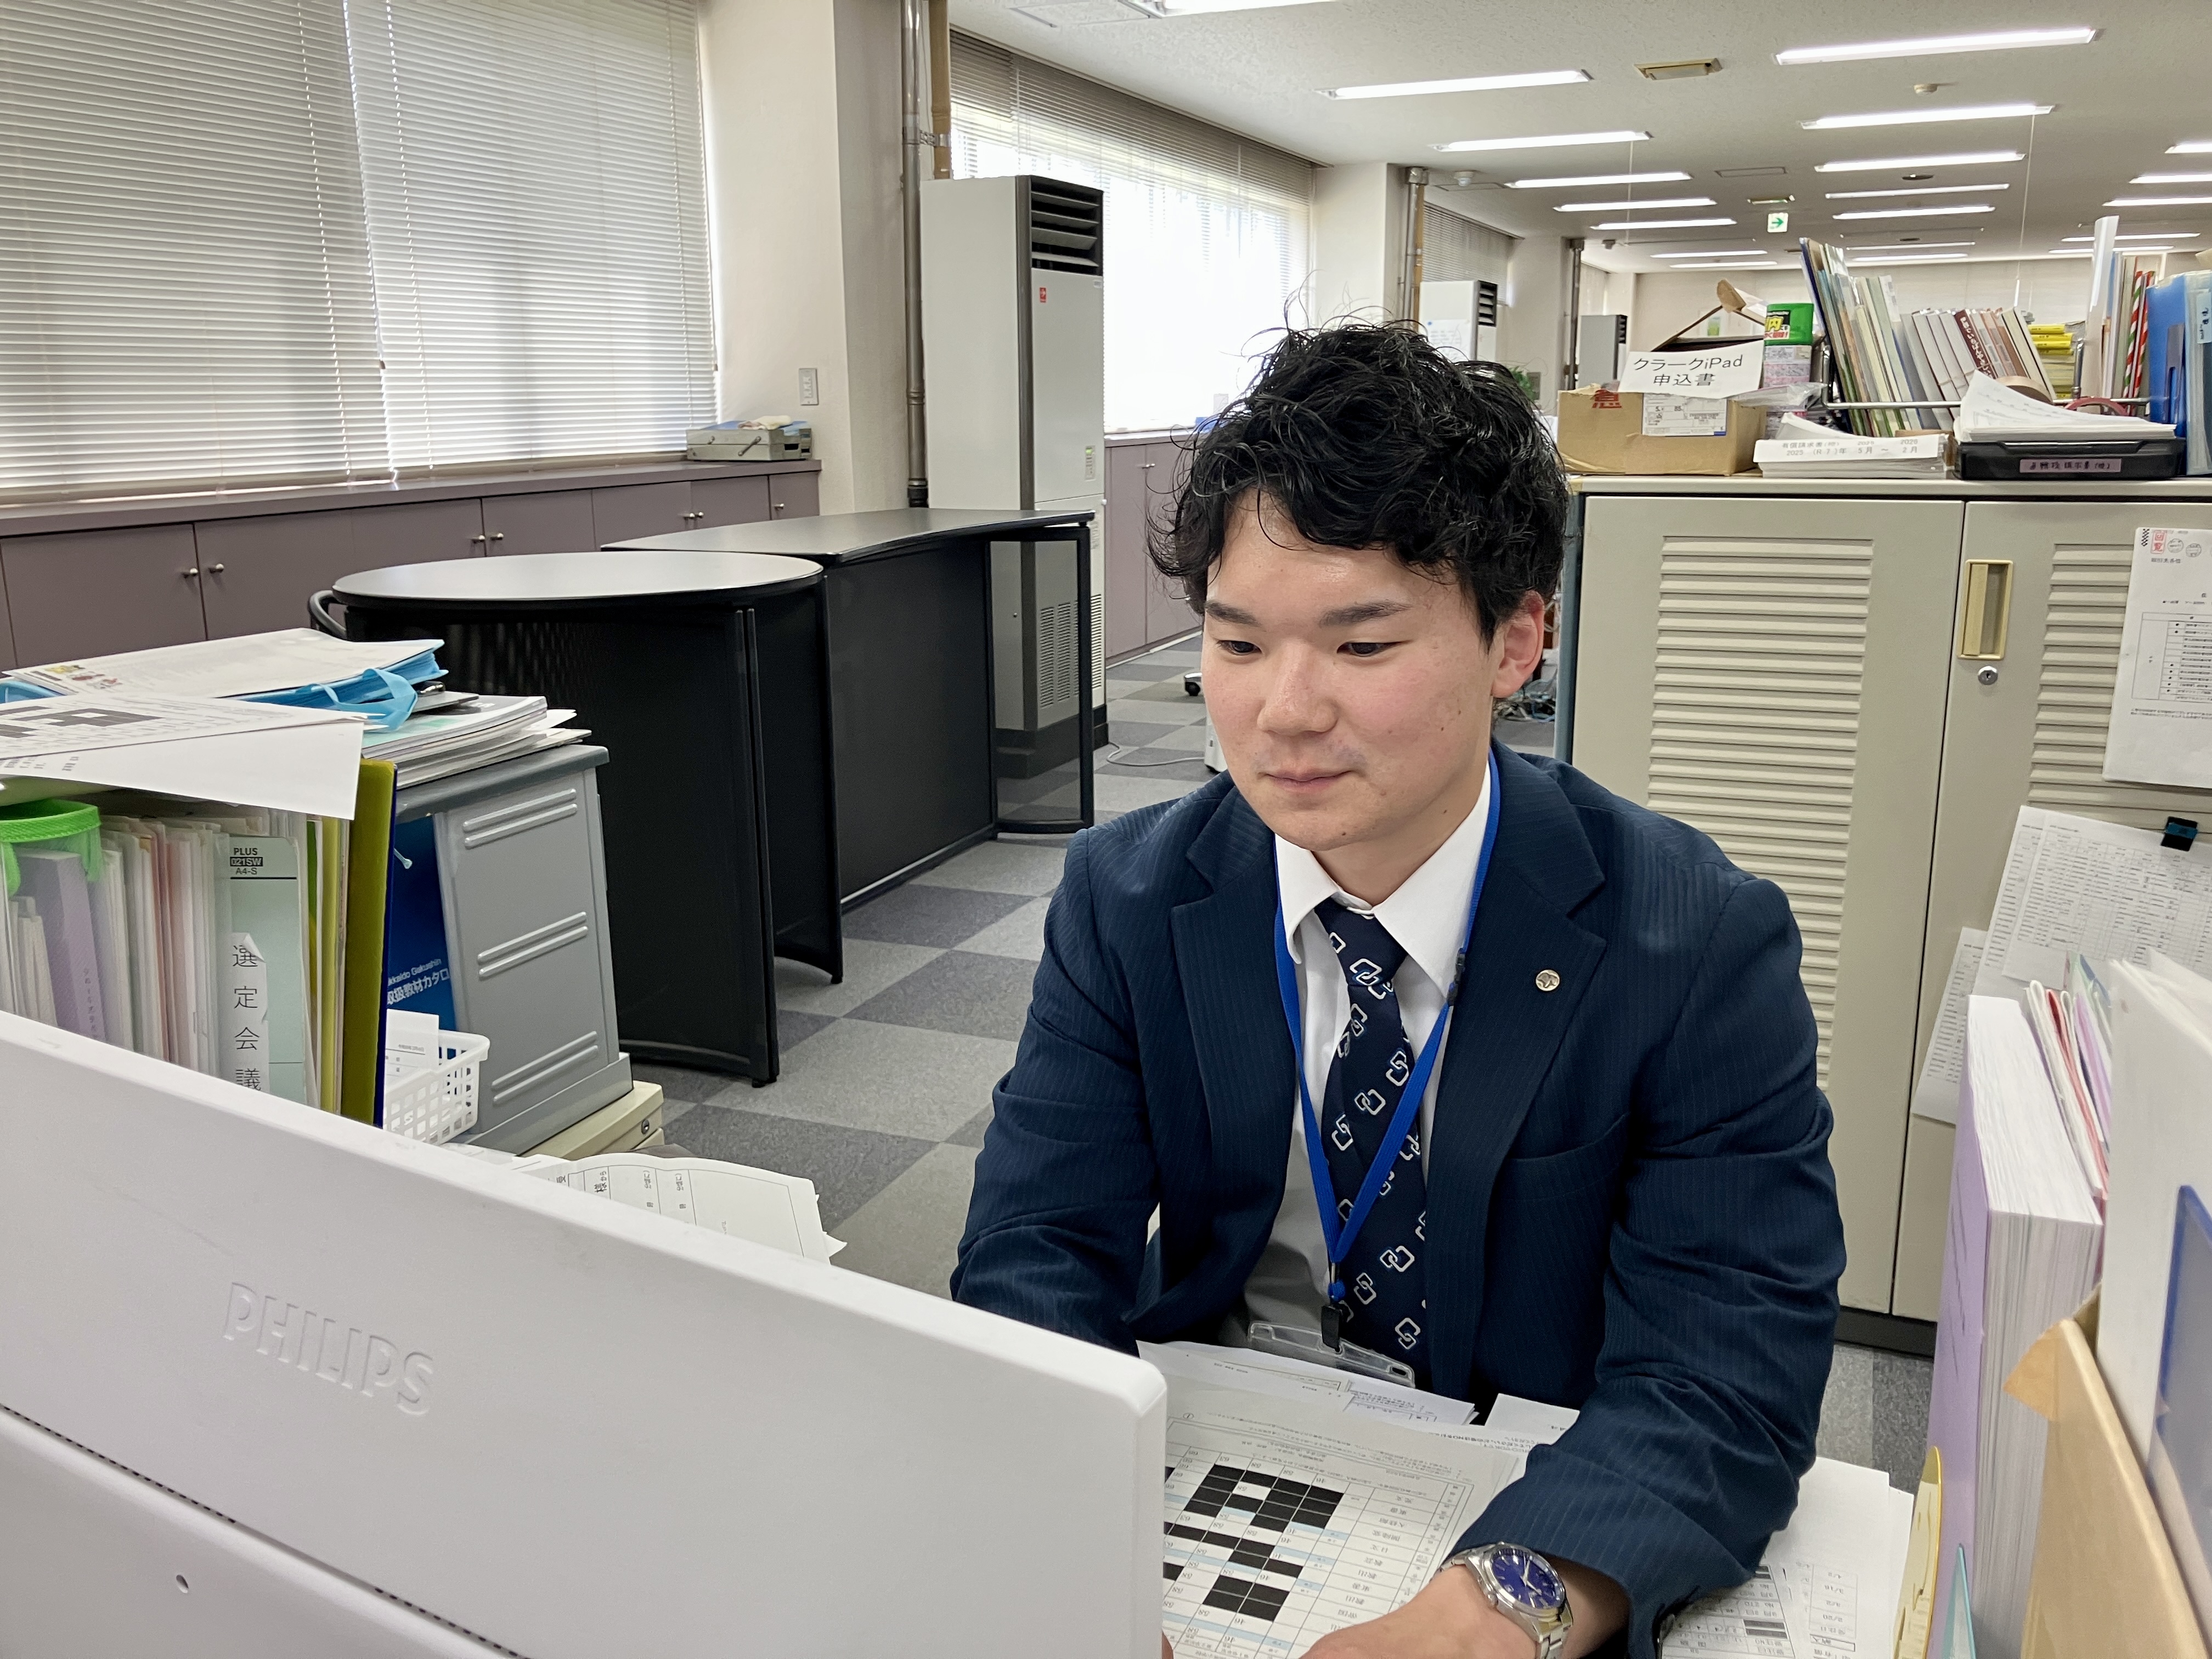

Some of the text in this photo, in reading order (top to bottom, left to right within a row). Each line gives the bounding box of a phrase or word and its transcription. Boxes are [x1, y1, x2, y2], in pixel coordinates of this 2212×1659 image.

[1633, 354, 1743, 371] クラークiPad
[1653, 373, 1716, 386] 申込書
[1901, 445, 1917, 454] 2月
[233, 848, 258, 856] PLUS
[235, 867, 258, 876] A4-S
[232, 944, 262, 1091] 選定会議
[222, 1282, 435, 1417] PHILIPS
